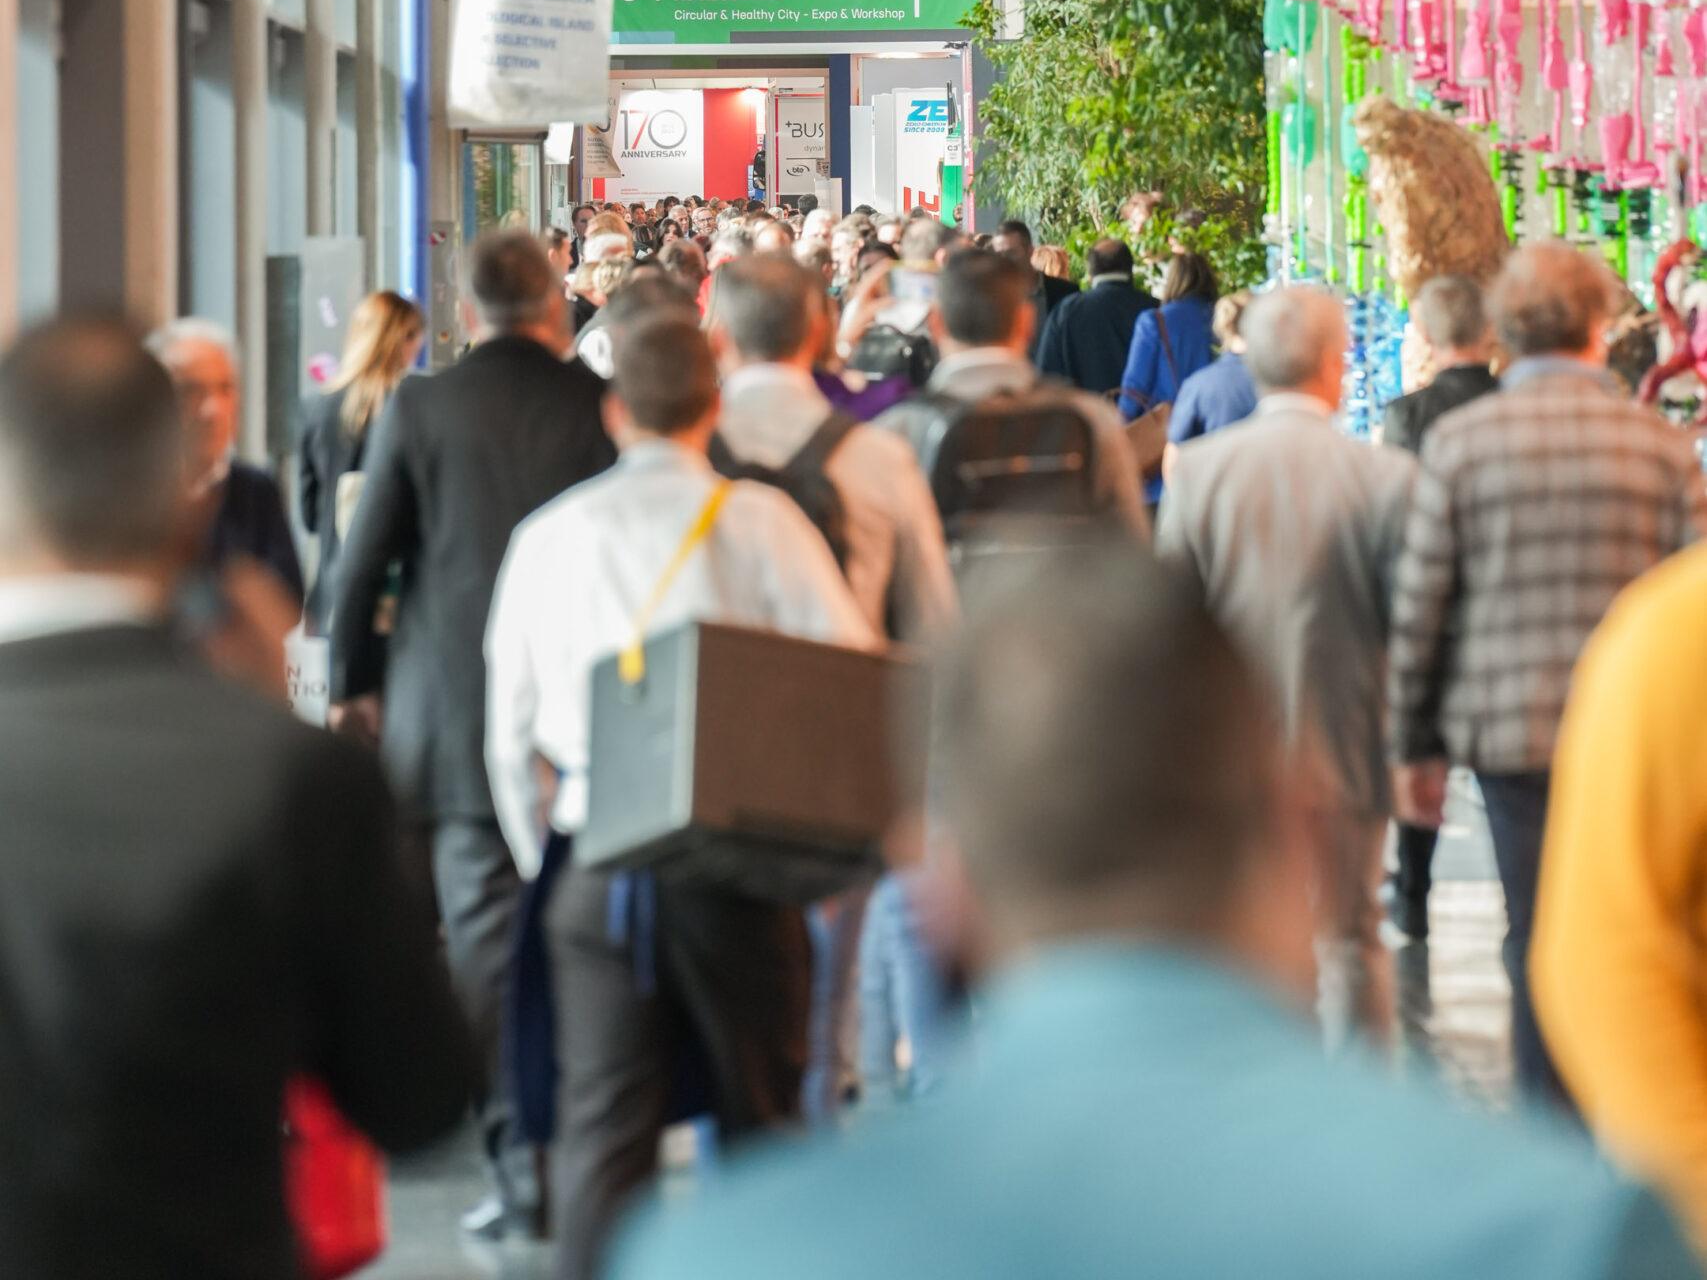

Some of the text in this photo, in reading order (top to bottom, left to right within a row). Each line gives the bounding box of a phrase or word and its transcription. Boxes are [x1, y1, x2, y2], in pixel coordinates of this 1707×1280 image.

[674, 9, 717, 20] Circular
[720, 9, 728, 20] &
[732, 9, 774, 22] Healthy
[777, 8, 801, 22] City
[812, 8, 838, 22] Expo
[841, 8, 848, 19] &
[851, 8, 905, 21] Workshop
[620, 109, 688, 150] 170
[621, 150, 688, 158] ANNIVERSARY
